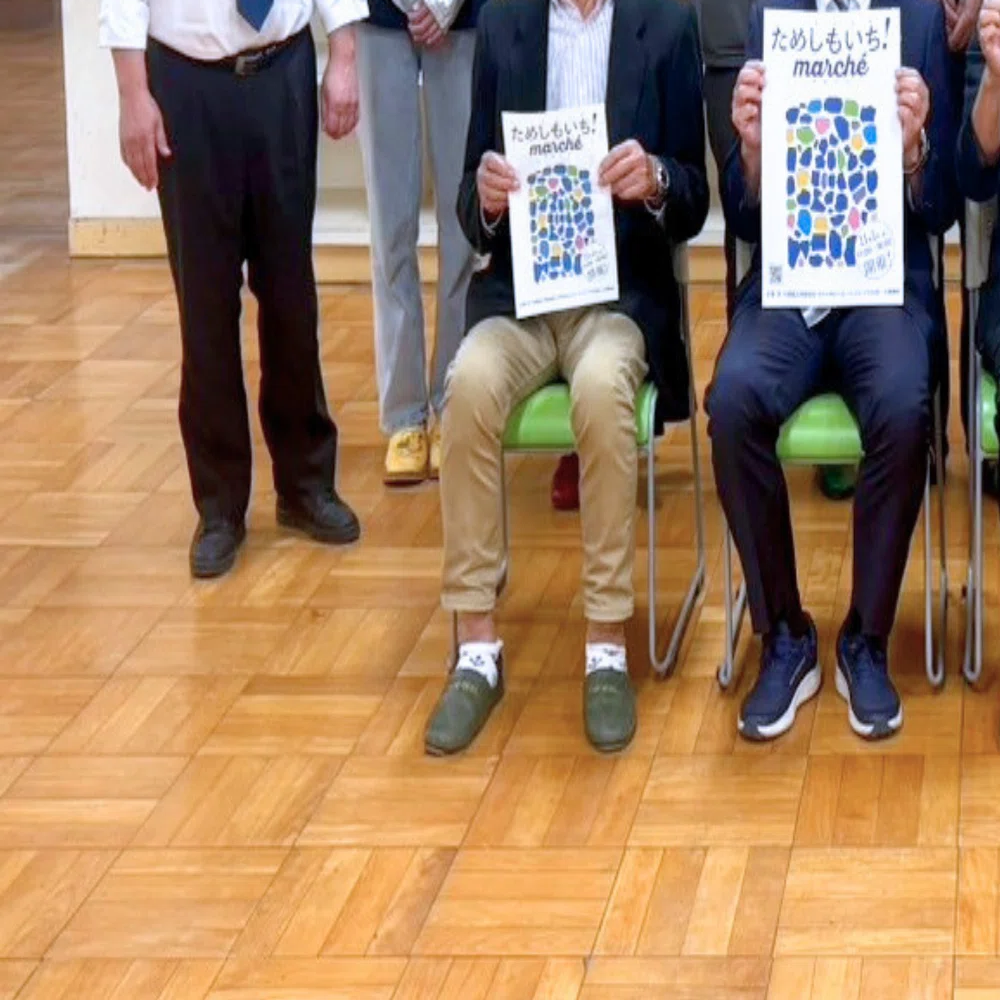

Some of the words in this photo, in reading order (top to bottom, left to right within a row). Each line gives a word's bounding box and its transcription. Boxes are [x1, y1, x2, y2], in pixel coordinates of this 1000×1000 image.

[771, 17, 891, 53] ためしもいち!
[793, 52, 869, 78] marché
[511, 113, 597, 142] ためしもいち!
[529, 137, 583, 156] marché
